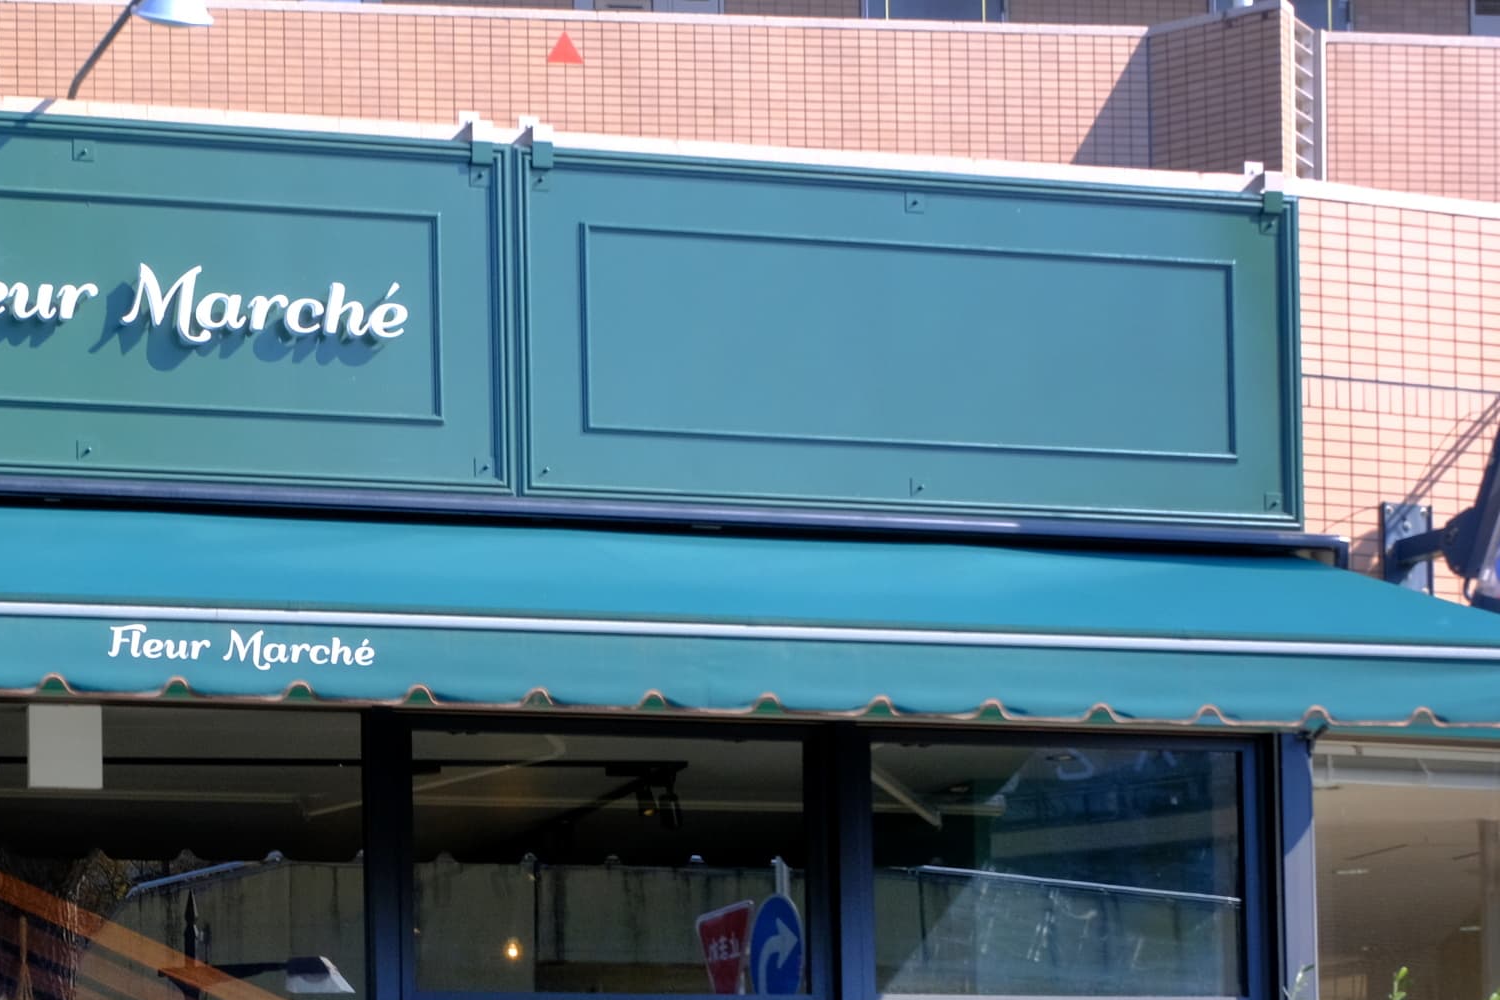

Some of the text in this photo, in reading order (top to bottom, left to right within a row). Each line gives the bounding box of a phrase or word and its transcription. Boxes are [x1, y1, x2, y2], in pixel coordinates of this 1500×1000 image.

[121, 262, 408, 343] Marché
[108, 623, 375, 671] Fleur Marché
